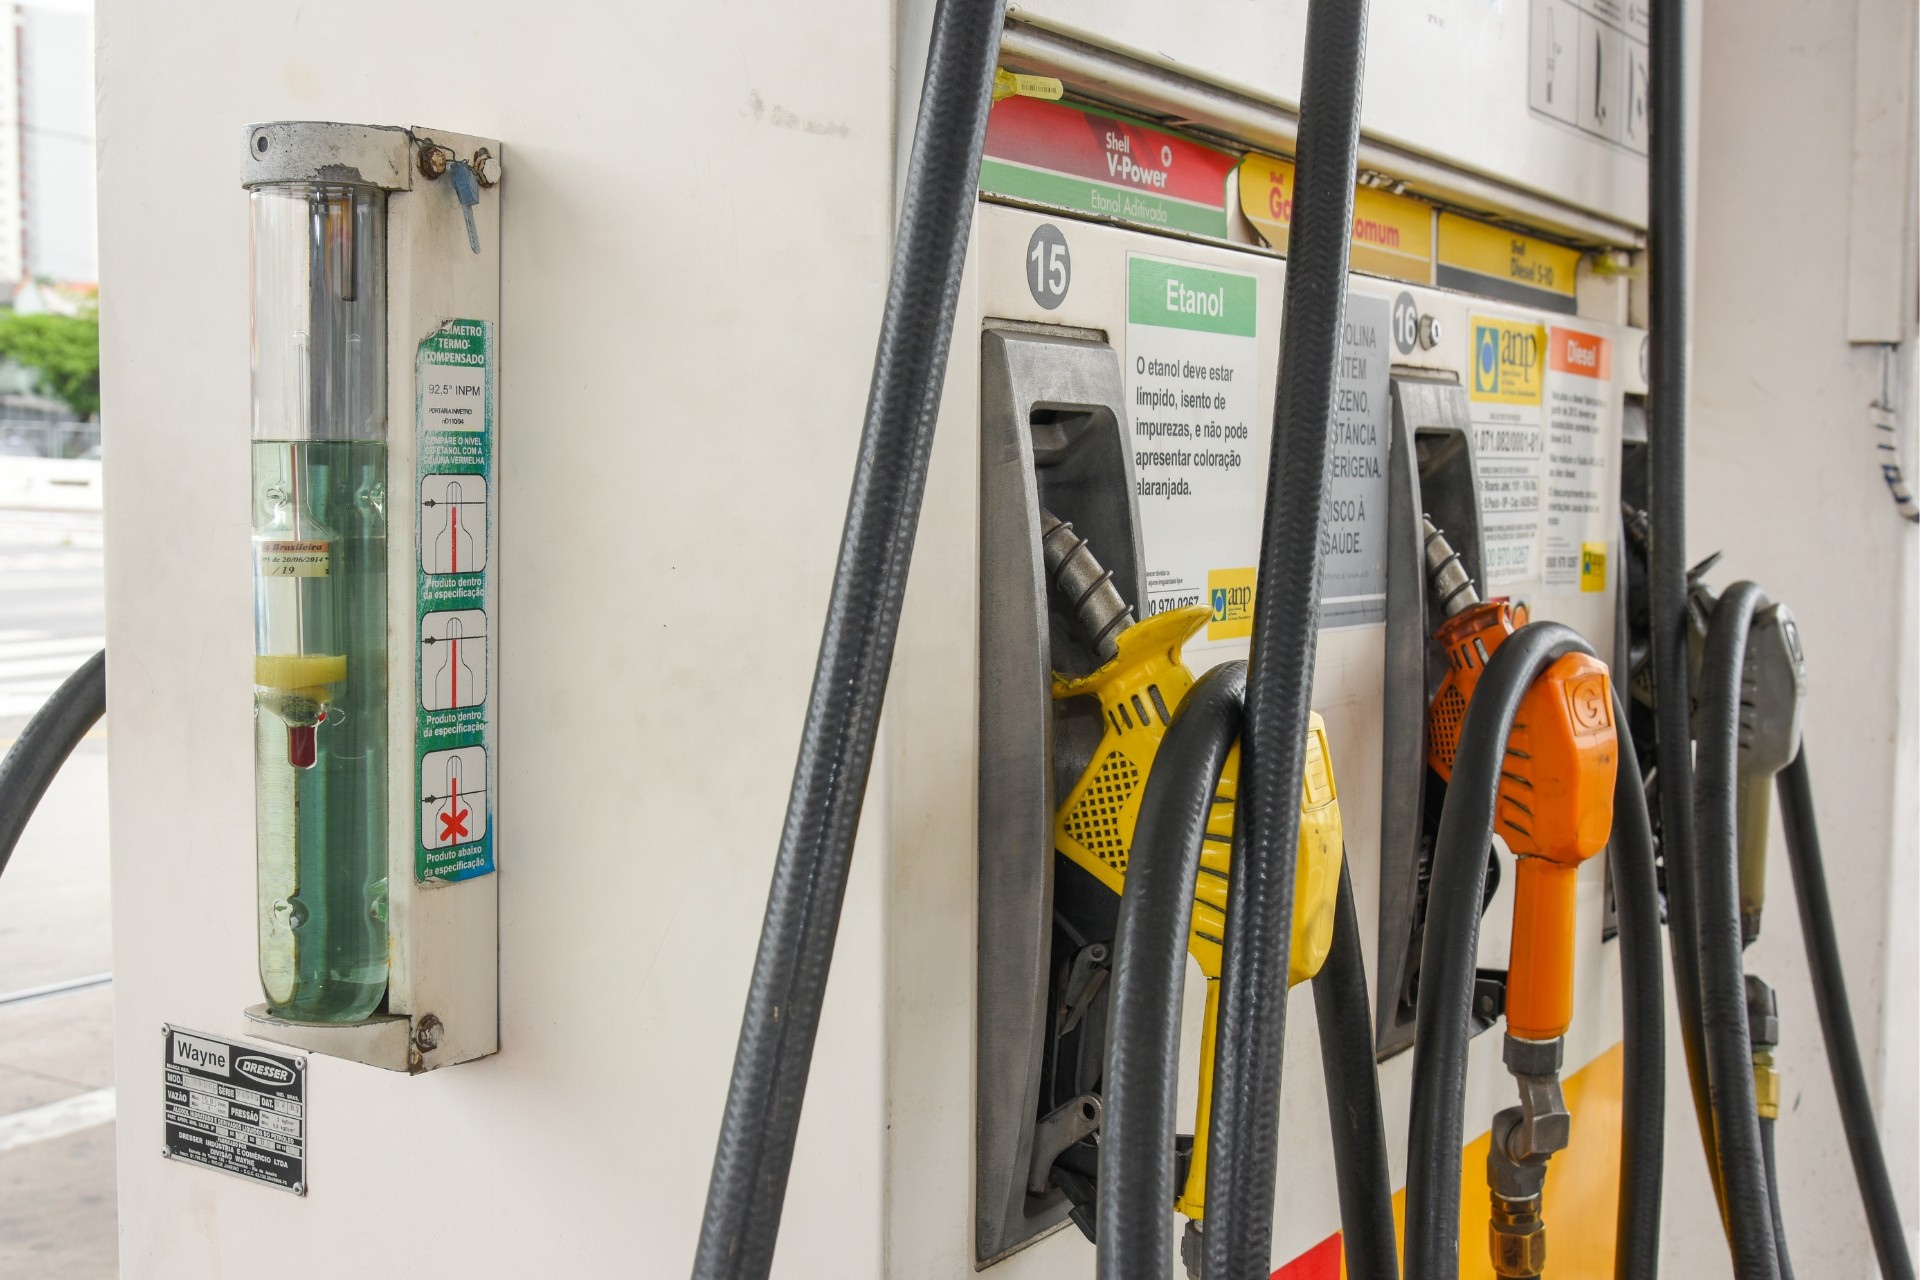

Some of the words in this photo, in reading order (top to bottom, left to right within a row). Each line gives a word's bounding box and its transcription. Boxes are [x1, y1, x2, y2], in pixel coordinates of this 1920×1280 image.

[1106, 132, 1130, 153] Shell
[1106, 152, 1168, 188] V-Power
[1092, 189, 1121, 214] Etanol
[1124, 196, 1168, 224] Aditivado
[1352, 216, 1400, 248] omum
[1031, 240, 1066, 295] 15
[1166, 278, 1224, 318] Etanol
[1395, 304, 1416, 346] 16
[438, 338, 471, 350] TERMO-
[1344, 324, 1376, 348] OLINA
[425, 352, 484, 365] COMPENSADO
[1501, 329, 1538, 384] anp
[1567, 340, 1597, 367] Diesel
[1136, 356, 1145, 375] O
[1148, 358, 1180, 378] etanol
[1182, 361, 1207, 380] deve
[1209, 364, 1234, 382] estar
[455, 386, 480, 396] INPM
[1136, 386, 1178, 410] límpido,
[1180, 390, 1212, 409] isento
[1214, 392, 1226, 410] de
[1136, 417, 1192, 440] impurezas,
[1195, 424, 1201, 438] e
[1204, 420, 1222, 438] não
[1224, 422, 1248, 443] pode
[436, 446, 462, 454] ETANOL
[462, 446, 476, 454] COM
[464, 436, 482, 446] NÍVEL
[450, 456, 485, 465] VERMELHA
[1136, 448, 1192, 470] apresentar
[1194, 449, 1242, 472] coloração
[1136, 478, 1192, 500] alaranjada.
[1328, 500, 1355, 522] ISCO
[272, 543, 322, 551] Brasileira
[427, 578, 458, 588] Produto
[458, 578, 482, 587] dentro
[424, 590, 433, 600] da
[434, 588, 484, 600] especificação
[1228, 585, 1252, 612] anp
[426, 714, 457, 726] Produto
[458, 710, 482, 722] dentro
[424, 726, 432, 738] da
[434, 722, 485, 736] especificação
[426, 850, 456, 864] Produto
[458, 846, 482, 858] abaixo
[424, 867, 433, 878] da
[434, 858, 485, 874] especificação
[178, 1040, 226, 1068] Wayne
[167, 1072, 183, 1085] MOD.
[242, 1060, 288, 1081] DRESSER
[168, 1090, 188, 1103] VAZÃO
[218, 1085, 236, 1098] SÉRIE
[262, 1097, 274, 1108] DAT.
[230, 1106, 258, 1122] PRESSÃO
[178, 1132, 203, 1145] DRESSER
[206, 1138, 234, 1153] INDÚSTRIA
[242, 1147, 272, 1164] COMÉRCIO
[274, 1158, 288, 1168] LTDA
[210, 1147, 232, 1160] DIVISÃO
[234, 1156, 255, 1167] WAYNE
